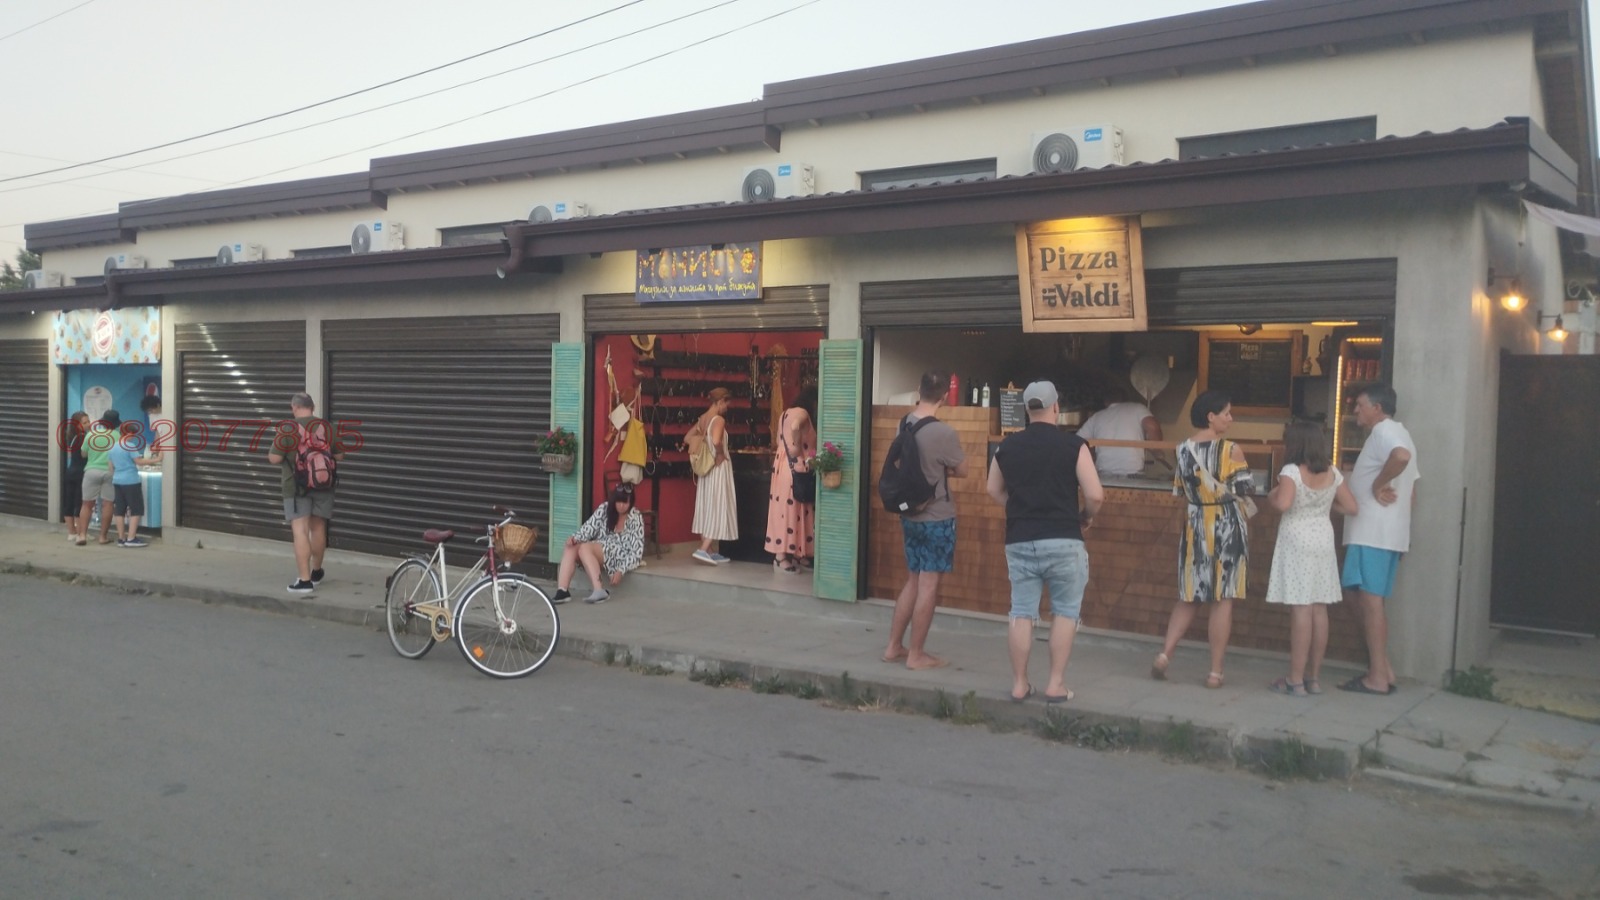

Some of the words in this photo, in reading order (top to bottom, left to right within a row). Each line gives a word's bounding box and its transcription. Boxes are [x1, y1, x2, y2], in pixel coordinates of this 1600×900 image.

[1039, 246, 1118, 271] Pizza
[1042, 287, 1057, 308] di
[1054, 282, 1119, 307] Valdi
